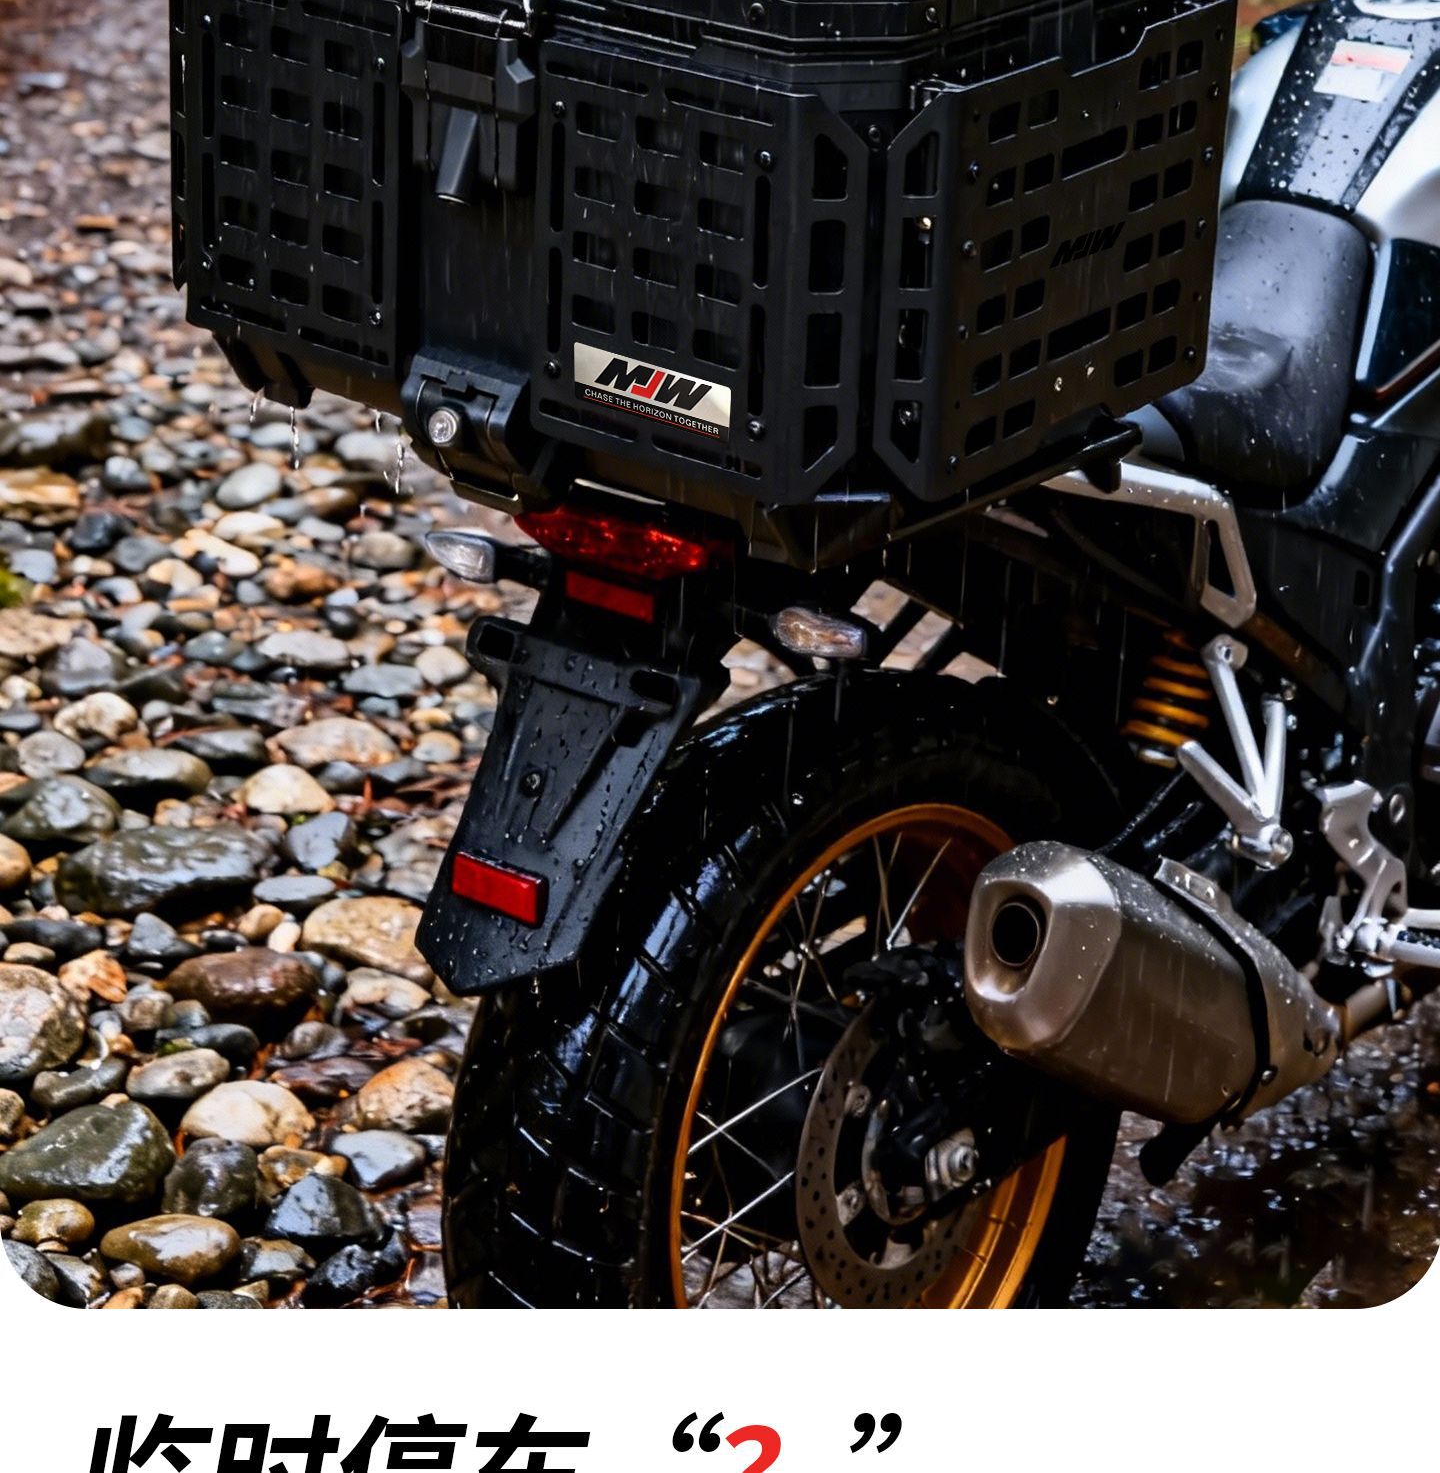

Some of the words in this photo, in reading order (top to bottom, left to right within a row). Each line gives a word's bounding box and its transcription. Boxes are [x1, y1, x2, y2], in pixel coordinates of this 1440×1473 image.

[594, 357, 712, 411] MJW
[584, 388, 614, 404] CHASE
[615, 397, 632, 409] THE
[632, 402, 672, 421] HORIZON
[674, 415, 720, 435] TOGETHER
